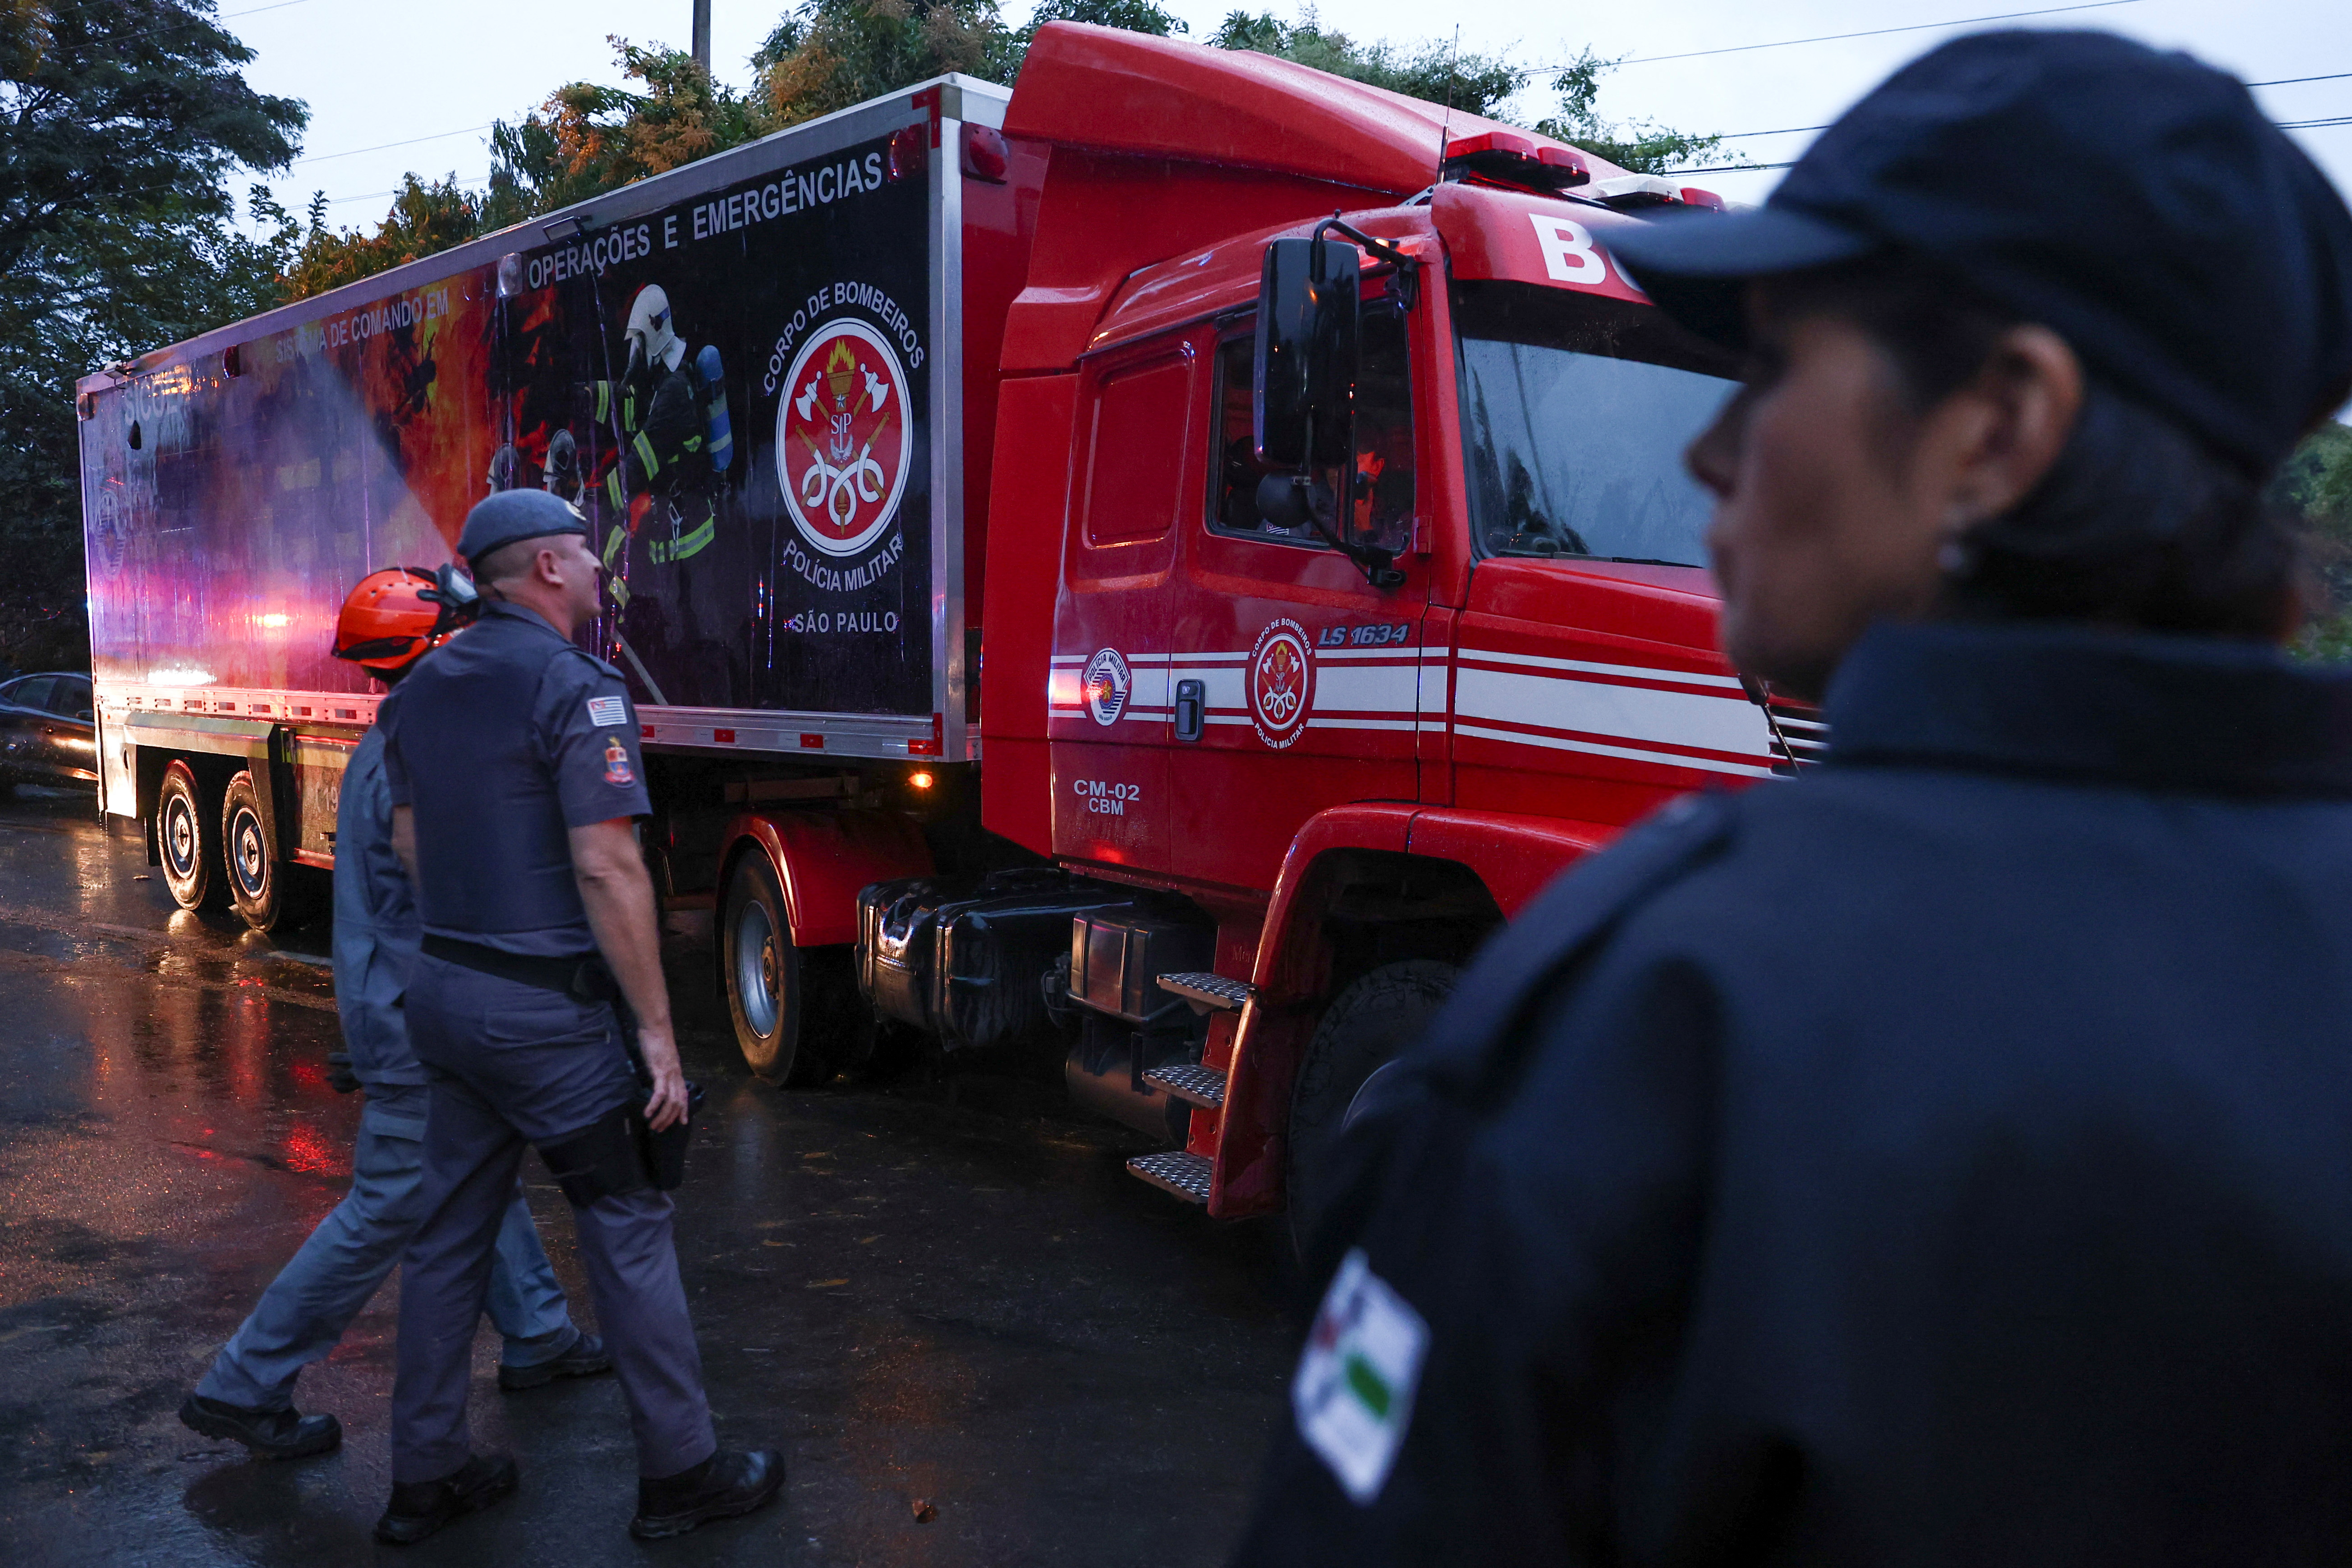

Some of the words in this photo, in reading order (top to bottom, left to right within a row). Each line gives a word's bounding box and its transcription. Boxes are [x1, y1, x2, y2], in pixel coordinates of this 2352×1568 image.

[529, 224, 650, 289] OPERAÇÕES
[664, 215, 677, 248] E
[694, 152, 882, 240] EMERGÊNCIAS
[1529, 213, 1644, 292] B
[331, 320, 348, 347] DE
[352, 297, 423, 341] COMANDO
[427, 289, 448, 319] EM
[763, 310, 806, 392] CORPO
[808, 287, 830, 318] DE
[835, 281, 924, 368] BOMBEIROS
[785, 538, 841, 591] POLÍCIA
[845, 533, 903, 591] MILITAR
[795, 609, 829, 633] SÃO
[837, 611, 896, 632] PAULO
[1253, 626, 1270, 658] CORPO
[1271, 619, 1279, 629] DE
[1281, 618, 1311, 656] BOMBEIROS
[1317, 626, 1347, 646] LS
[1351, 623, 1409, 645] 1634
[1088, 654, 1107, 681] POLÍCIA
[1109, 654, 1126, 683] MILITAR
[1279, 722, 1305, 749] MILITAR
[1074, 779, 1140, 801] CM-02
[1089, 797, 1123, 815] CBM
